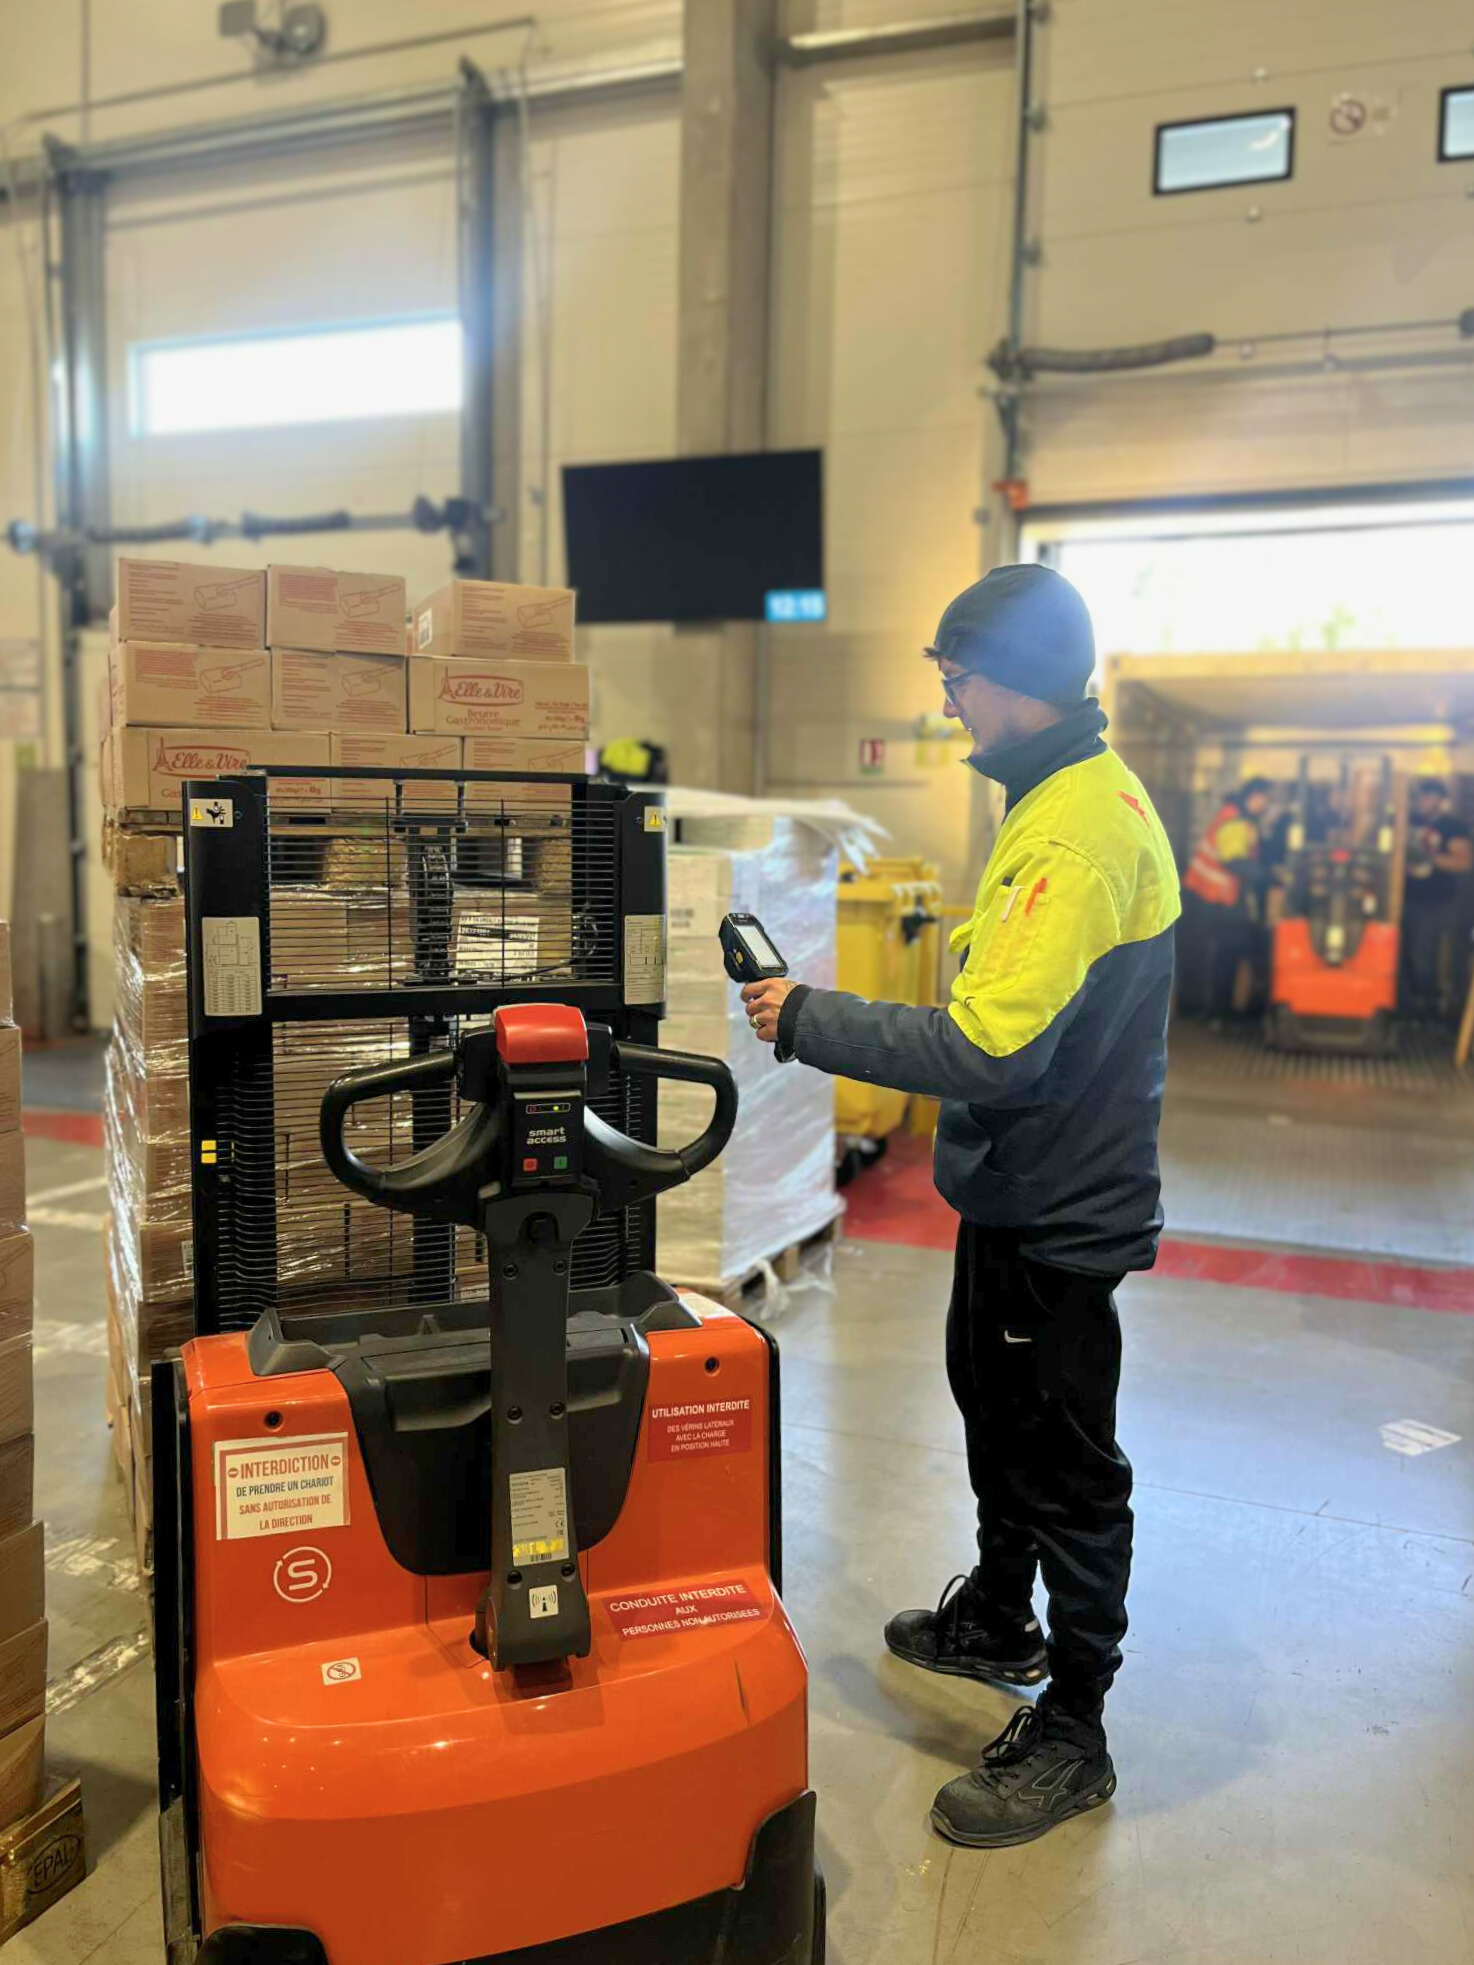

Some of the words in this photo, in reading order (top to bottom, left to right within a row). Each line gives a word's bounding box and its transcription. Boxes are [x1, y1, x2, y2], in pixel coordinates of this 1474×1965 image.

[455, 680, 483, 698] Elle
[493, 682, 521, 699] Vire
[446, 715, 521, 729] Gastronomique
[467, 709, 499, 719] Beurre
[172, 752, 204, 770] Elle
[213, 753, 247, 770] Vire
[529, 1126, 565, 1137] smart
[526, 1135, 567, 1145] access
[652, 1404, 705, 1419] UTILISATION
[706, 1399, 750, 1413] INTERDITE
[667, 1424, 680, 1433] DES
[675, 1433, 692, 1442] AVEC
[693, 1432, 701, 1440] LA
[701, 1429, 726, 1439] CHARGE
[671, 1443, 680, 1452] EN
[681, 1441, 709, 1451] POSITION
[710, 1439, 730, 1448] HAUTE
[241, 1453, 329, 1479] INTERDICTION
[236, 1486, 247, 1498] DE
[249, 1481, 286, 1496] PRENDRE
[287, 1480, 299, 1491] UN
[300, 1476, 334, 1490] CHARIOT
[239, 1503, 261, 1515] SANS
[262, 1495, 320, 1512] AUTORISATION
[321, 1494, 332, 1504] DE
[260, 1519, 270, 1530] LA
[271, 1514, 313, 1528] DIRECTION
[287, 1558, 319, 1591] S
[610, 1593, 677, 1612] CONDUITE
[679, 1584, 747, 1602] INTERDITE
[675, 1604, 698, 1615] AUX
[622, 1620, 681, 1636] PERSONNES
[34, 1843, 69, 1887] EPAL
